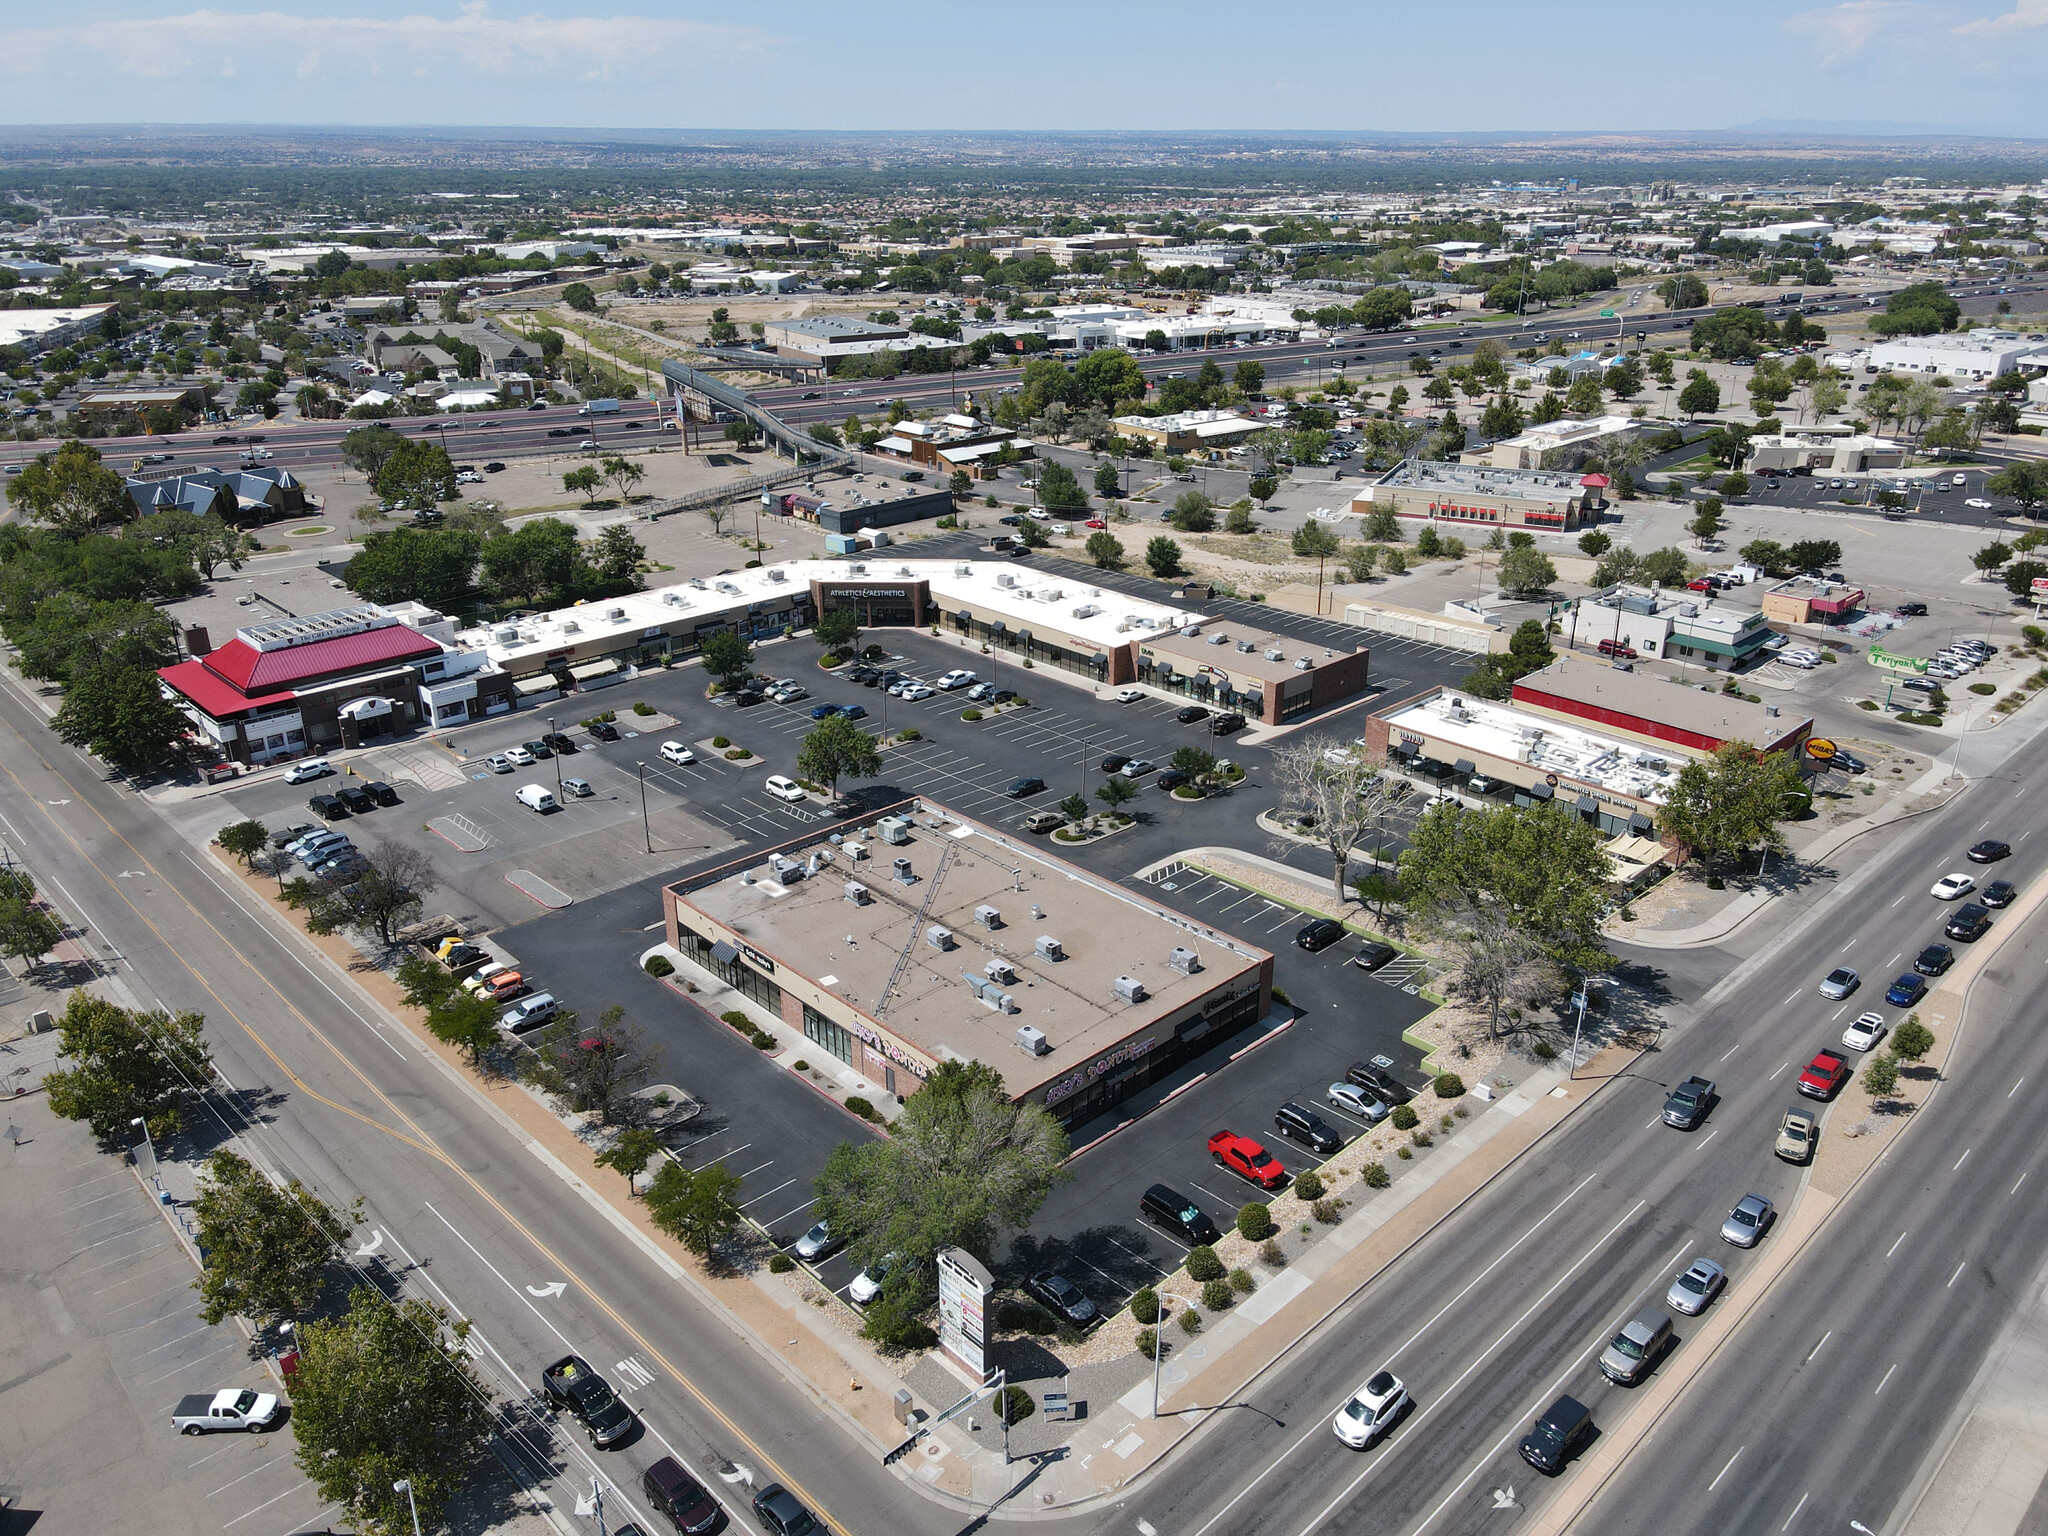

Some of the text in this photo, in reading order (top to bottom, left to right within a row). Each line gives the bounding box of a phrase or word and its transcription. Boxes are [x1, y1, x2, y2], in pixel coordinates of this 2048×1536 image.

[311, 629, 334, 639] GREAT
[336, 626, 360, 634] Academy
[1872, 653, 1913, 668] Teriyaki
[1809, 744, 1834, 755] MIDAS
[611, 1352, 659, 1394] ONLY
